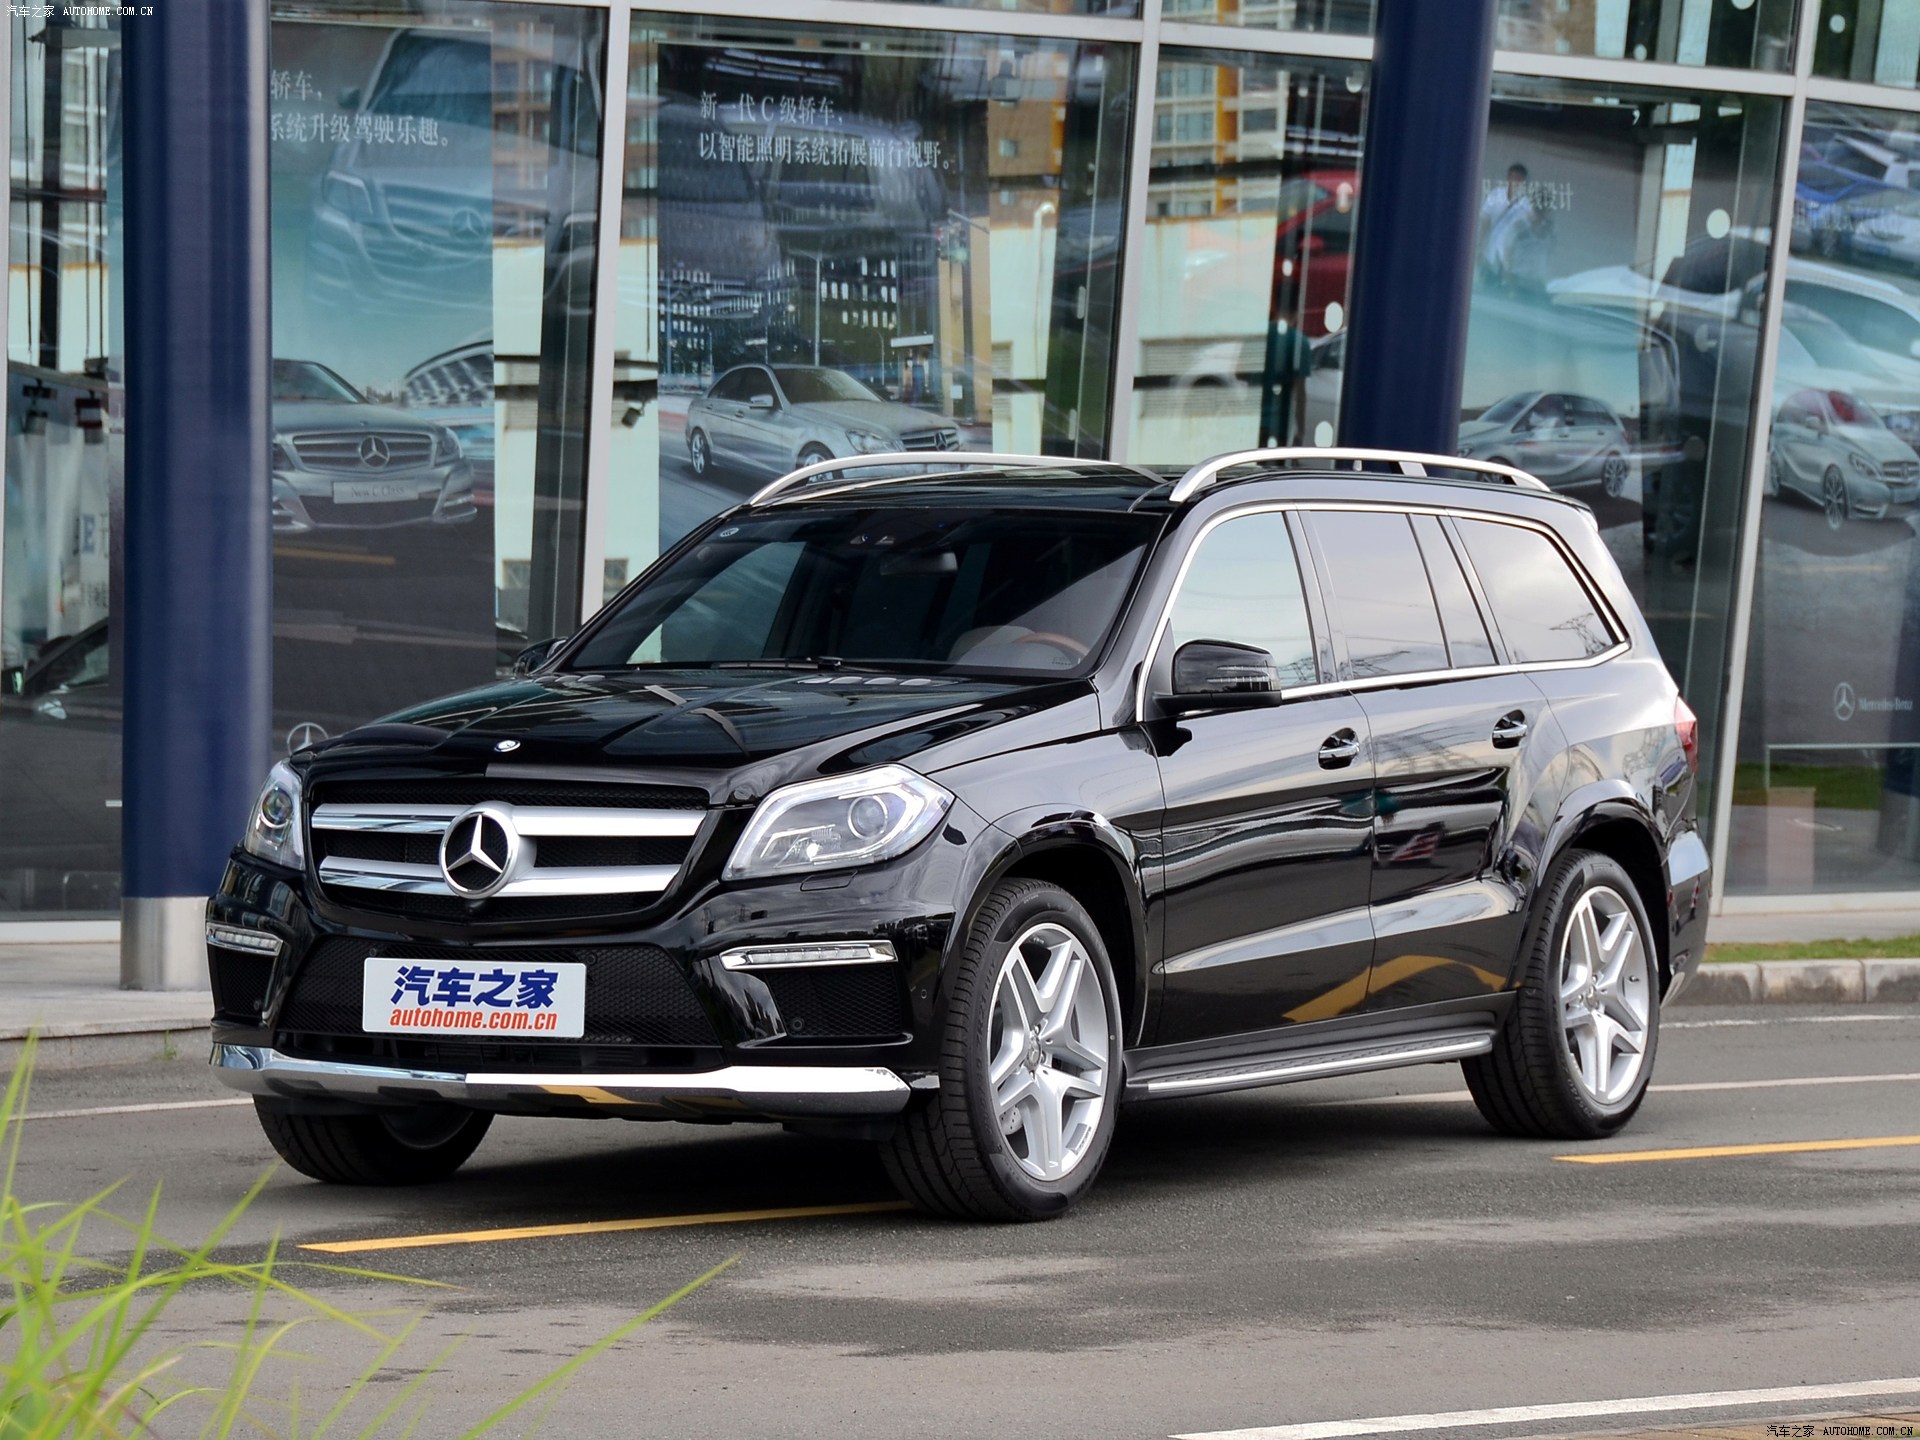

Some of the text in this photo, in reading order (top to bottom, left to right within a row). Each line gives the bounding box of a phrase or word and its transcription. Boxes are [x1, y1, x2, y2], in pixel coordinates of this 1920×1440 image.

[390, 965, 558, 1009] 汽车之家
[389, 1007, 558, 1030] autohome.com.cn
